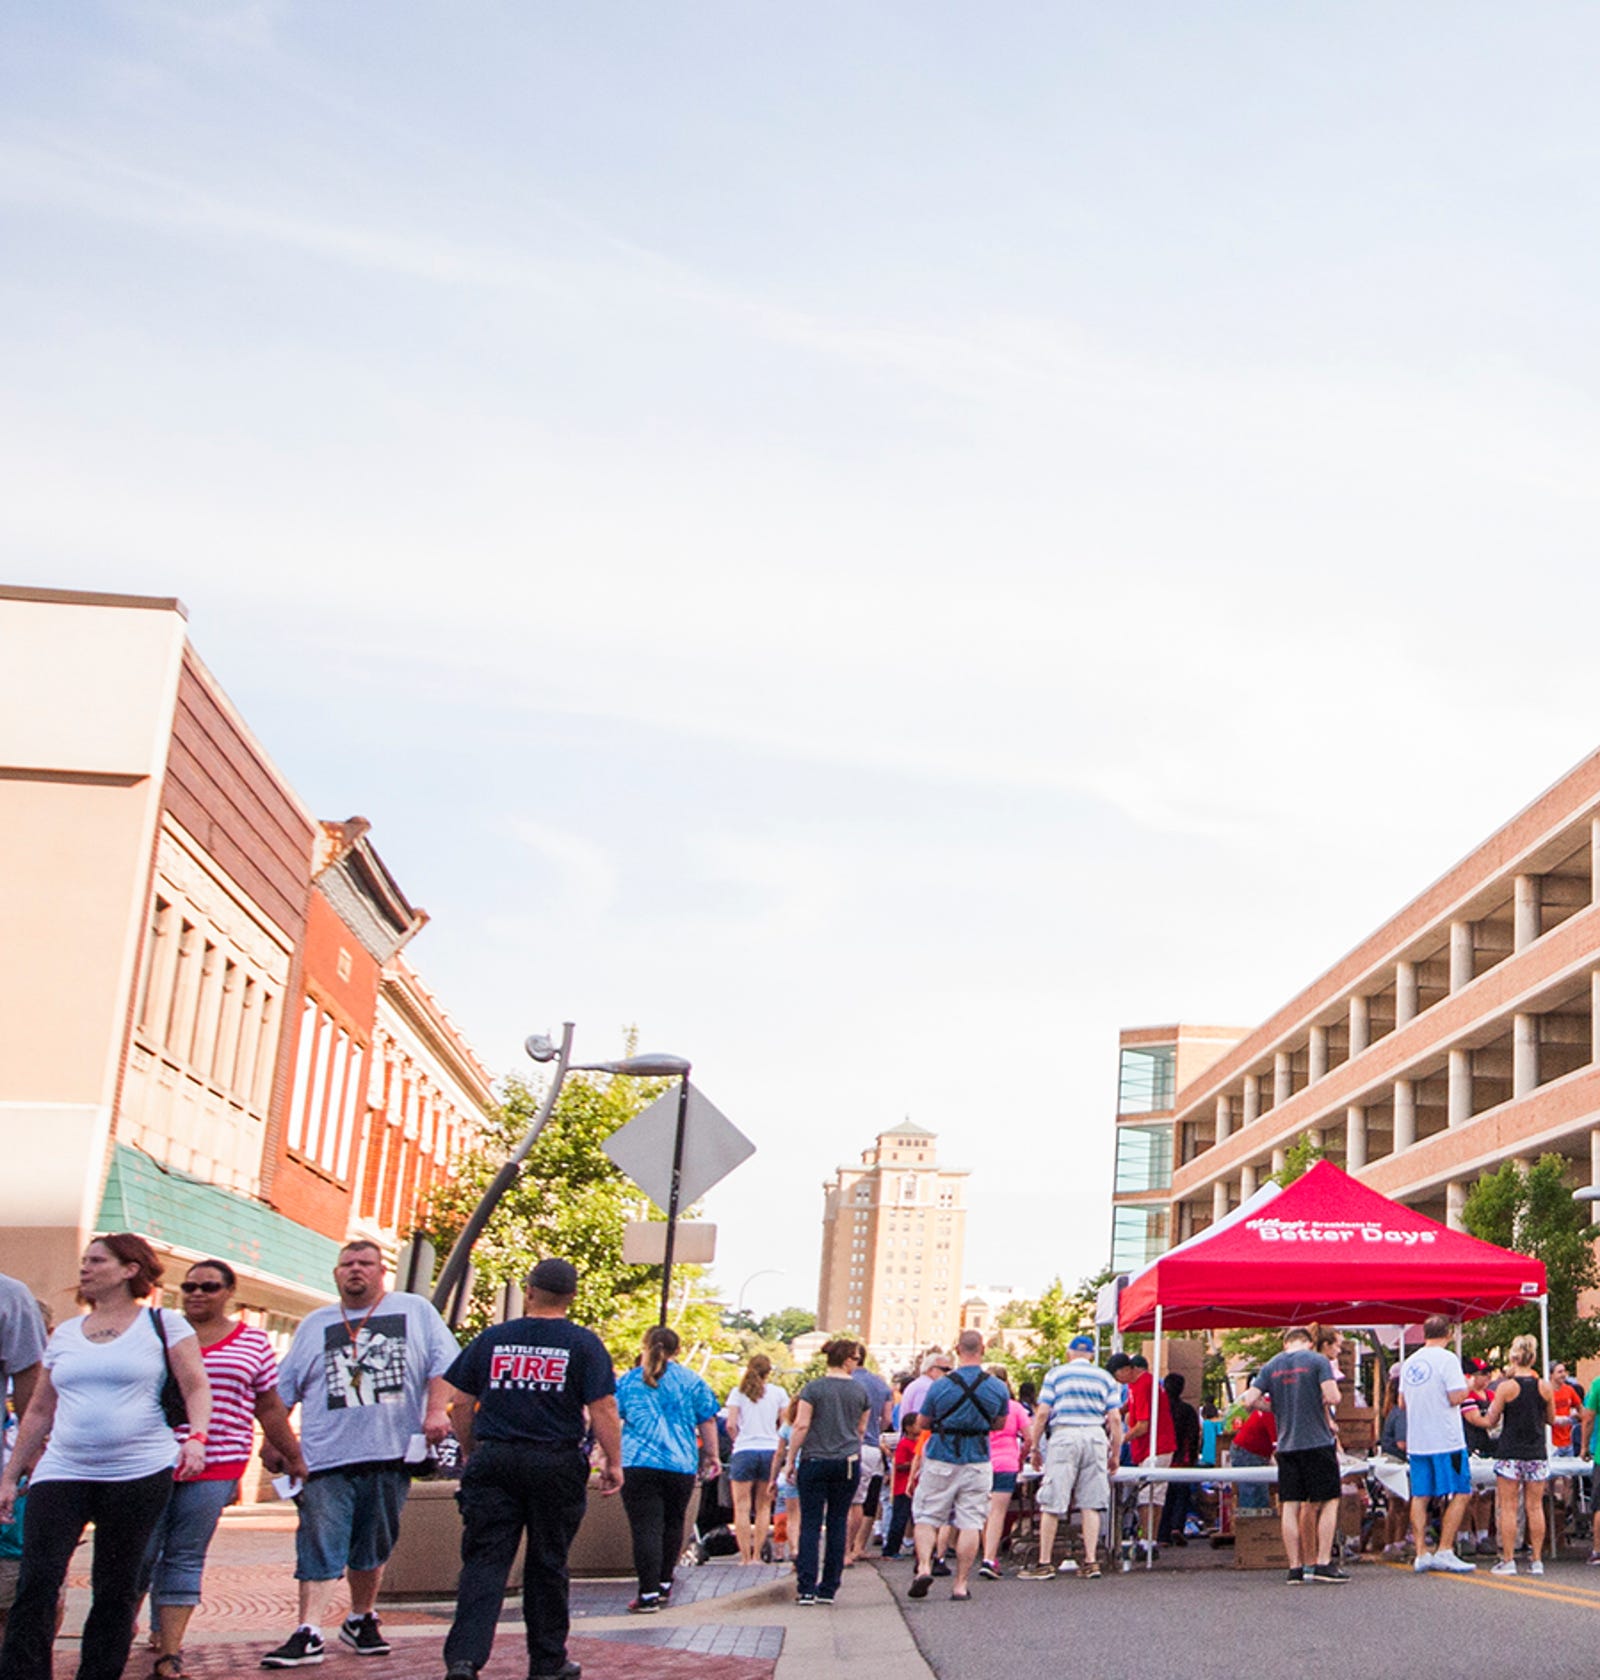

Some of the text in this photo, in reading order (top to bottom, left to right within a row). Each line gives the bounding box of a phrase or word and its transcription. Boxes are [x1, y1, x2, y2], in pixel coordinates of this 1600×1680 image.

[1259, 1227, 1437, 1245] Better Days
[493, 1344, 571, 1357] BATTLE CREEK
[491, 1353, 570, 1383] FIRE
[490, 1380, 565, 1392] RESCUE
